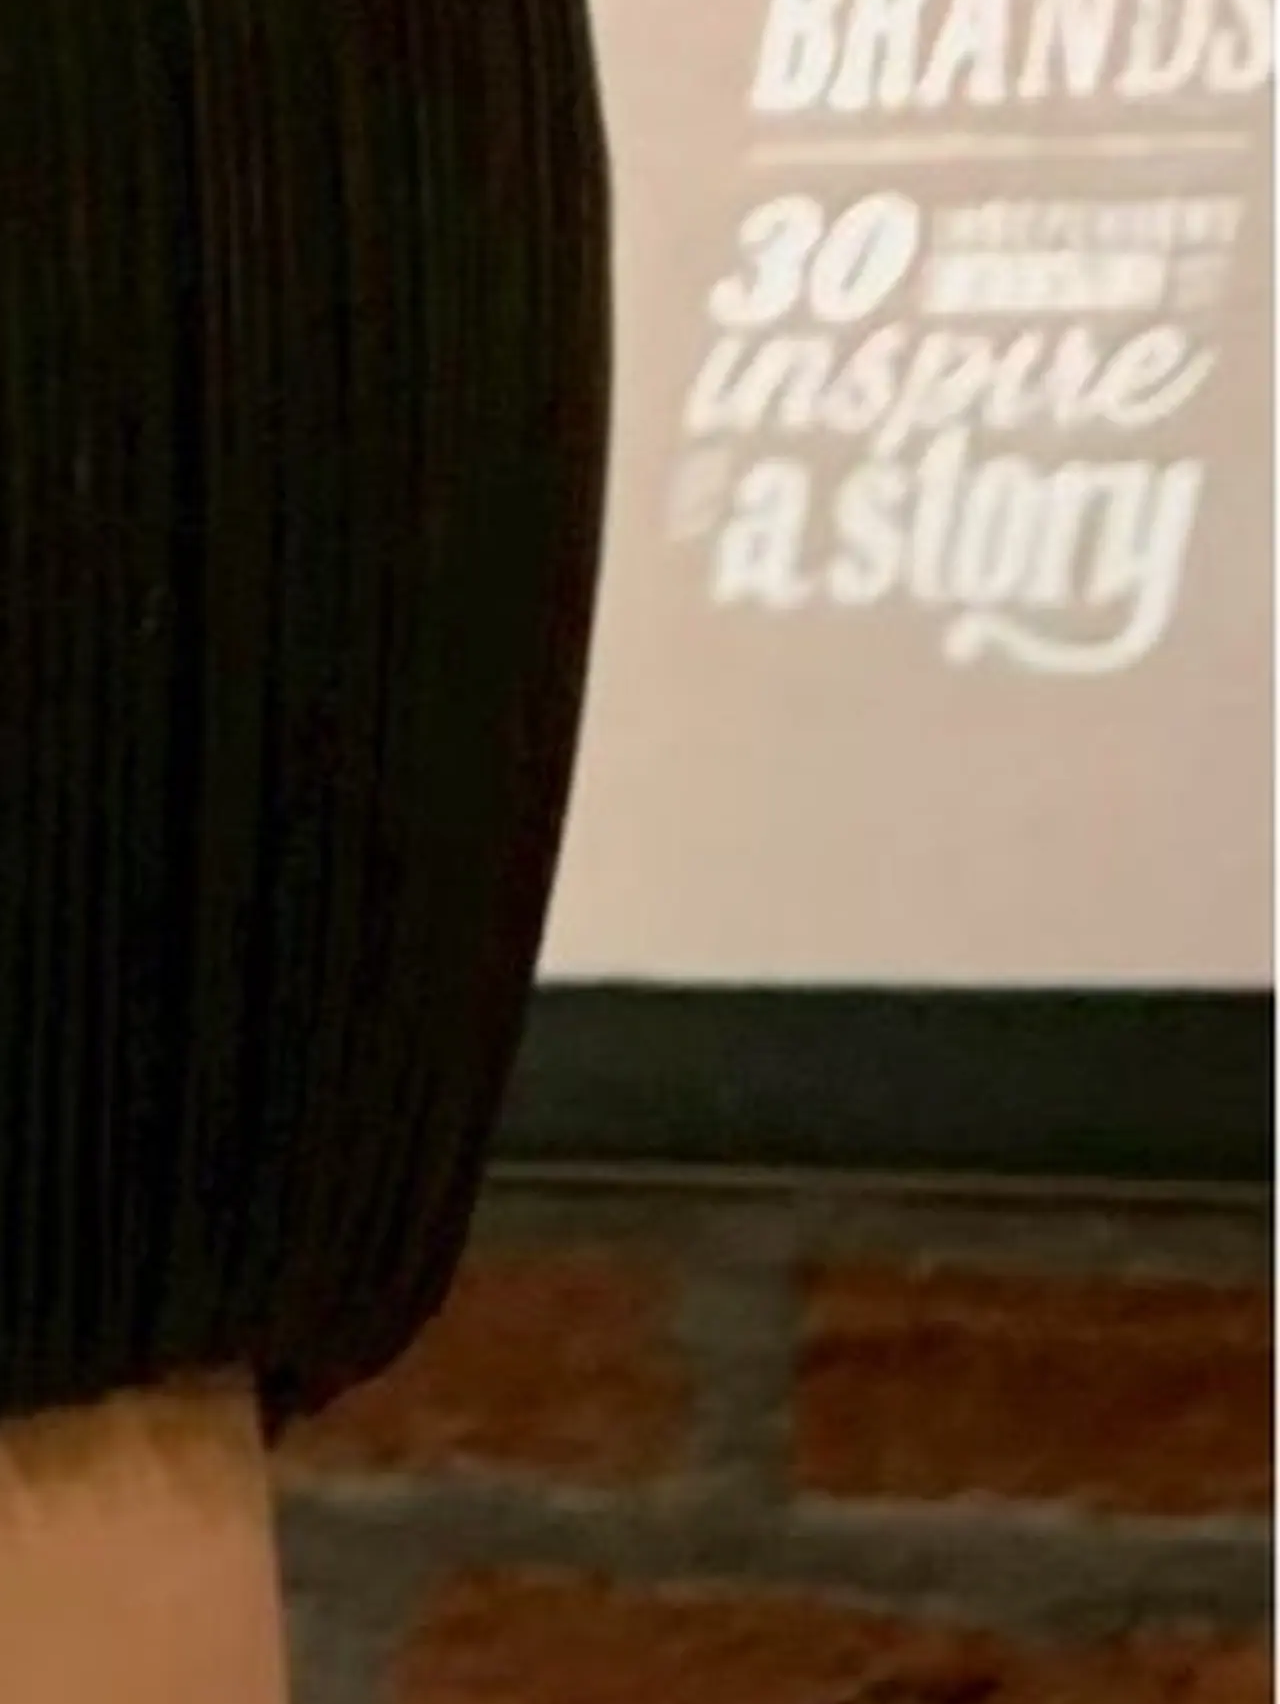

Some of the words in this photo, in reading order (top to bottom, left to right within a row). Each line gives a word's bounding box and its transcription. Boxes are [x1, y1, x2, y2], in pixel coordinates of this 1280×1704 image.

[708, 192, 920, 328] 30
[680, 325, 1217, 460] inspire
[710, 455, 810, 609] a
[828, 425, 1205, 673] story
